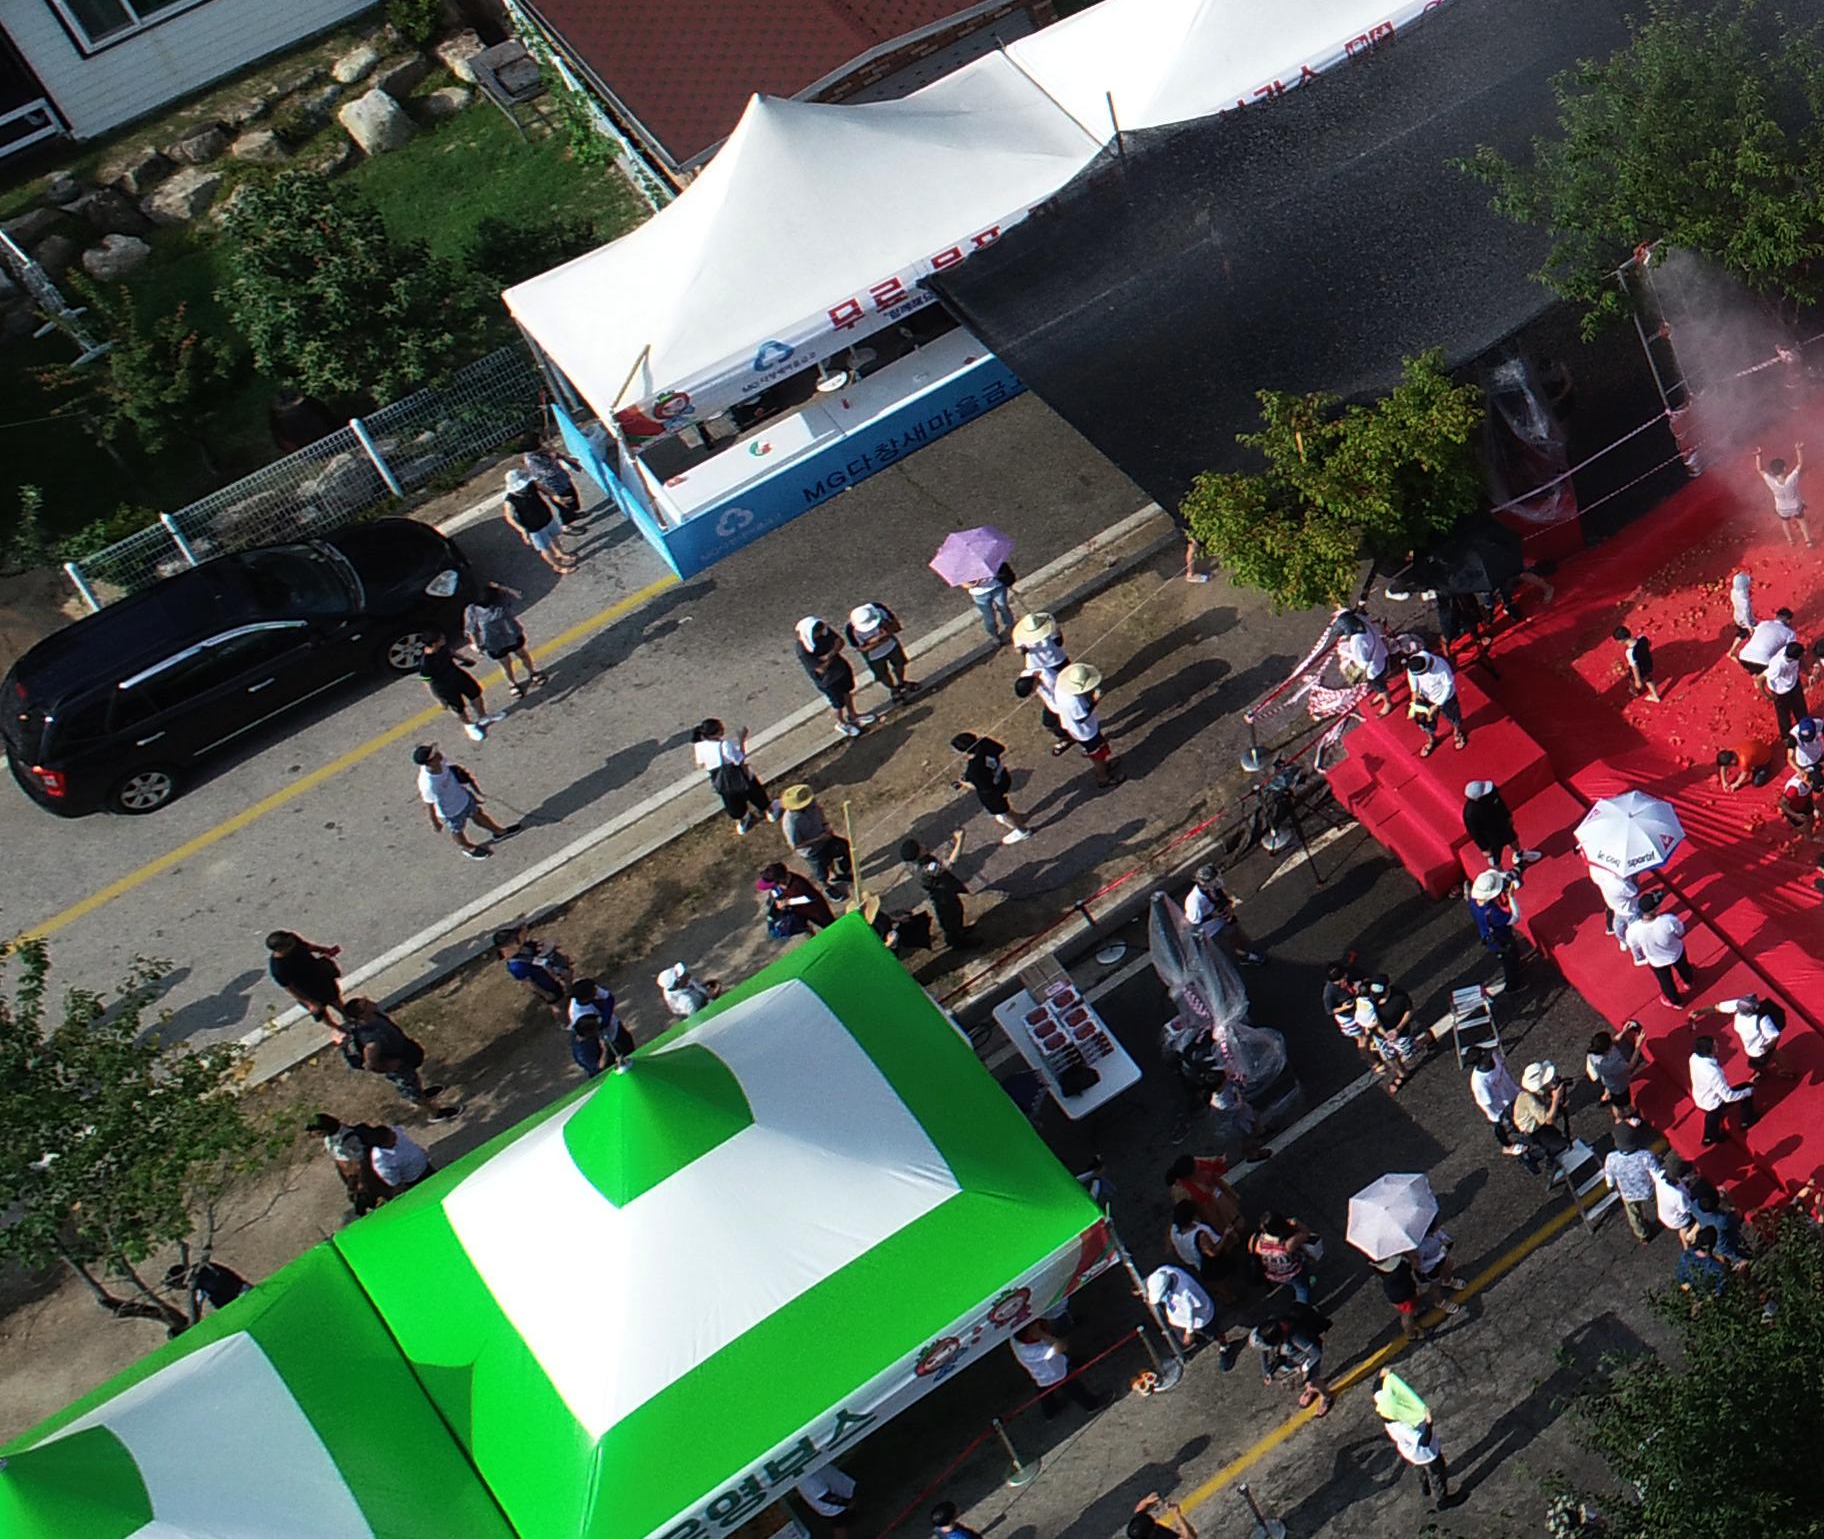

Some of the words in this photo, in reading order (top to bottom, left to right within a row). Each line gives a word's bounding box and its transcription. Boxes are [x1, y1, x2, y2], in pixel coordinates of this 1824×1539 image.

[827, 276, 909, 331] 무료
[1606, 856, 1621, 868] coq
[1627, 851, 1656, 867] sportif
